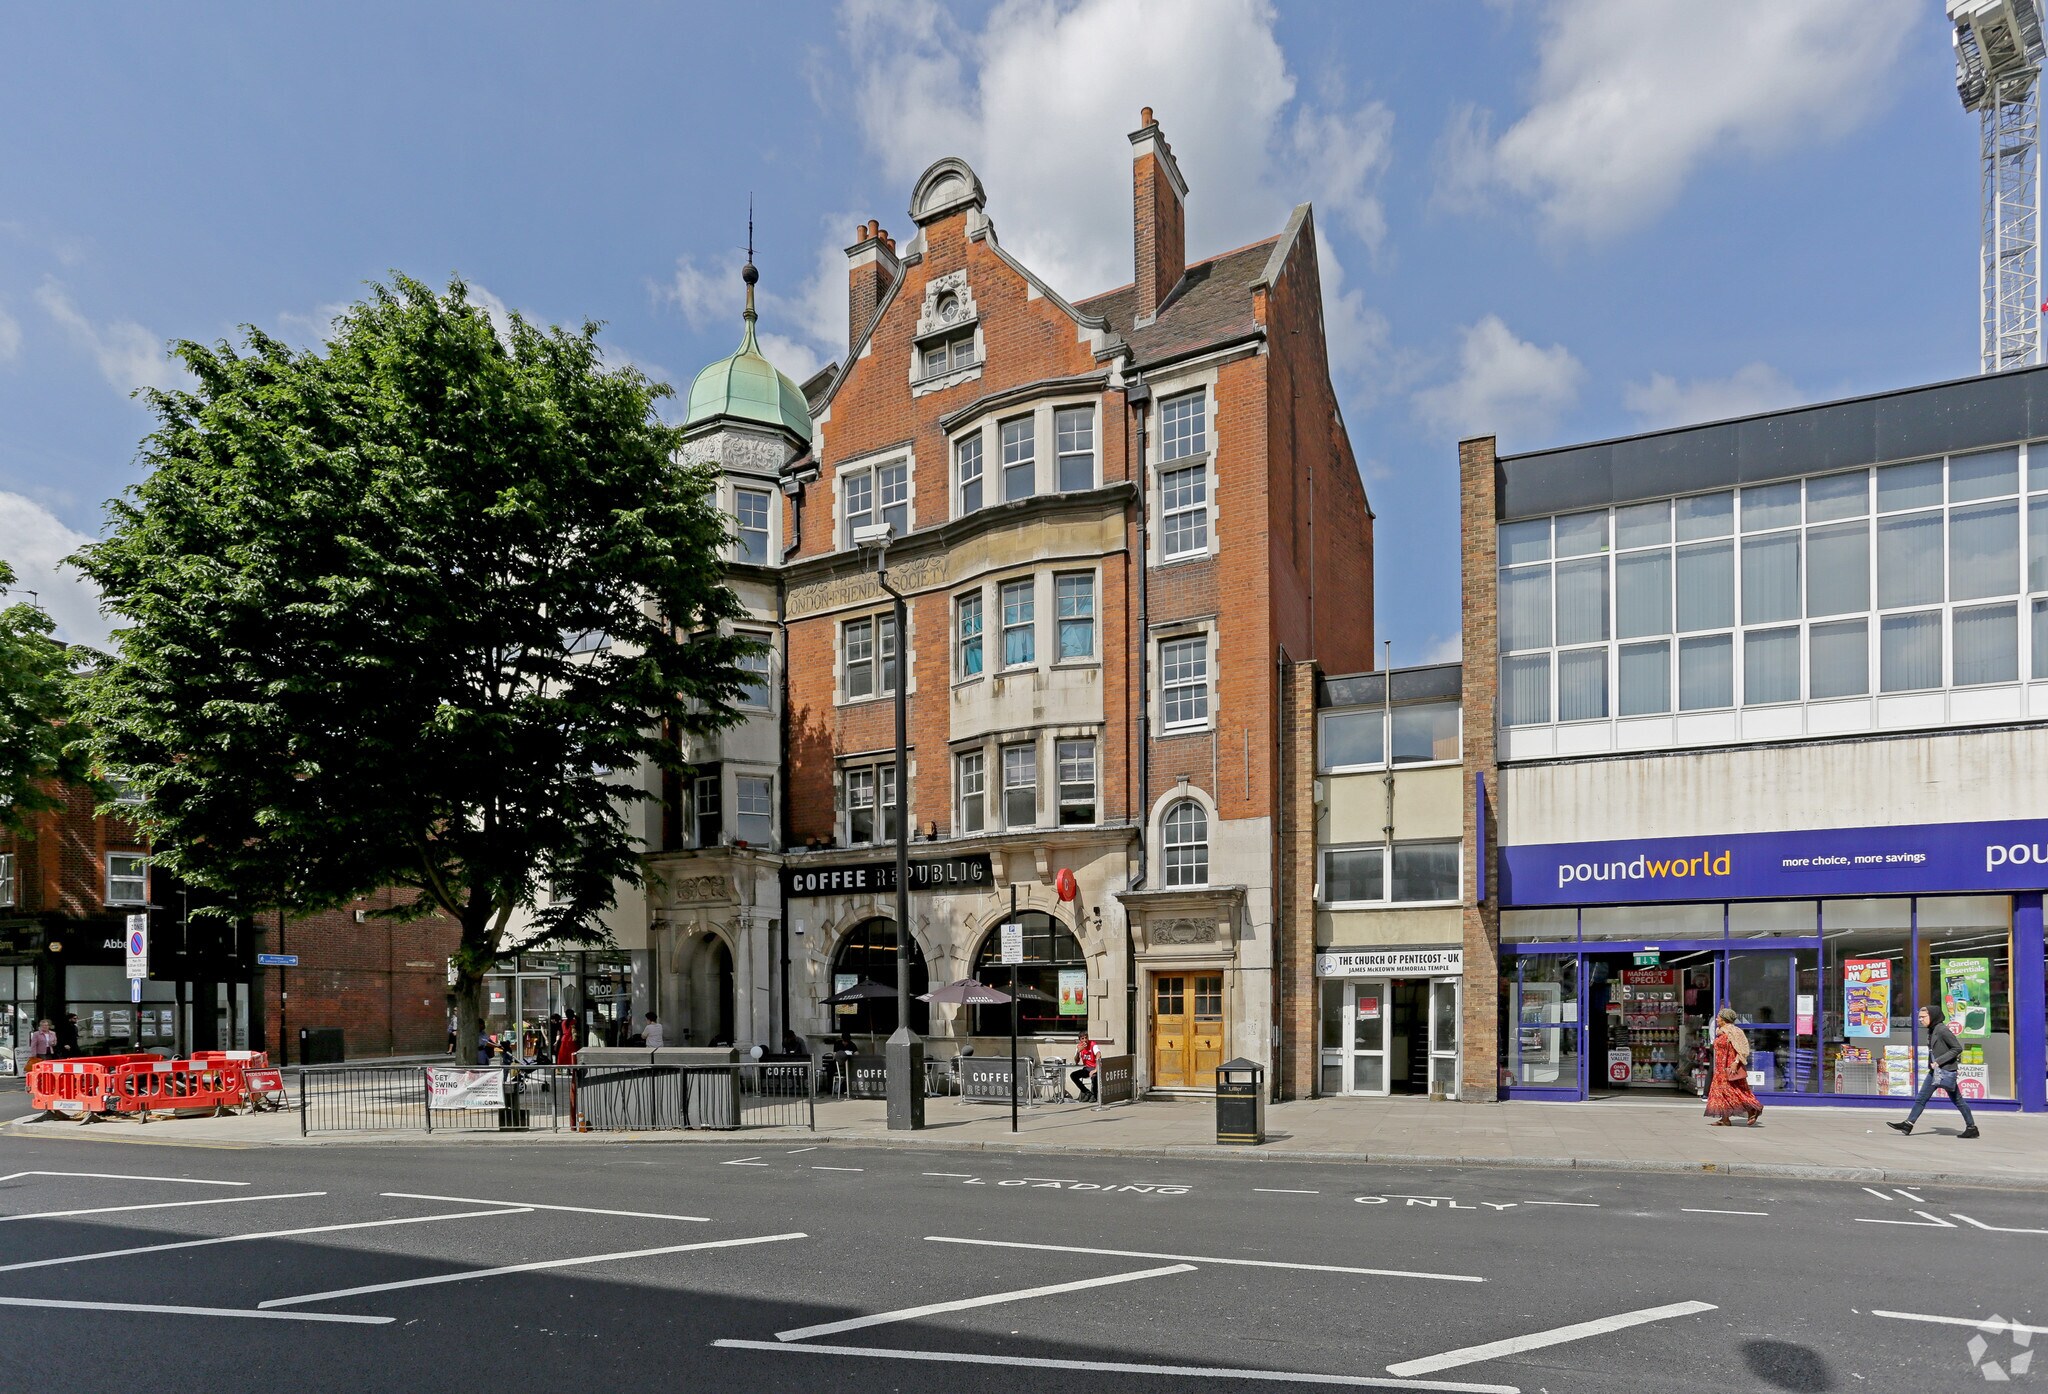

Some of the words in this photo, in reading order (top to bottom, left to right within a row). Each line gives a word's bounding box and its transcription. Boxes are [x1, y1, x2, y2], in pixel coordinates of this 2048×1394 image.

[831, 579, 886, 606] FRIENDL
[893, 567, 949, 592] SOCIETY
[1782, 857, 1809, 867] more
[1811, 854, 1851, 866] choice,
[1854, 854, 1883, 864] more
[1885, 851, 1926, 864] savings
[1558, 850, 1731, 888] poundworld
[793, 869, 867, 892] COFFEE
[1339, 956, 1352, 966] THE
[1354, 955, 1385, 966] CHURCH
[1387, 954, 1397, 964] OF
[1399, 953, 1442, 964] PENTECOST
[1447, 953, 1459, 963] UK
[1865, 961, 1887, 970] SAVE
[1948, 959, 1980, 968] Garden
[1945, 965, 1986, 975] Essentials
[1629, 976, 1665, 984] SPECIAL
[588, 980, 612, 996] shop
[767, 1067, 804, 1076] COFFEE
[856, 1068, 887, 1079] COFFE
[1105, 1068, 1128, 1082] COFFEE
[1614, 1068, 1626, 1079] £1
[434, 1074, 448, 1082] GET
[434, 1081, 458, 1089] SWING
[966, 1084, 1024, 1097] REPUBLC
[434, 1088, 449, 1096] FIT!
[1961, 1087, 1979, 1099] £1
[963, 1177, 1190, 1195] LOADING
[1354, 1196, 1518, 1211] ONLY
